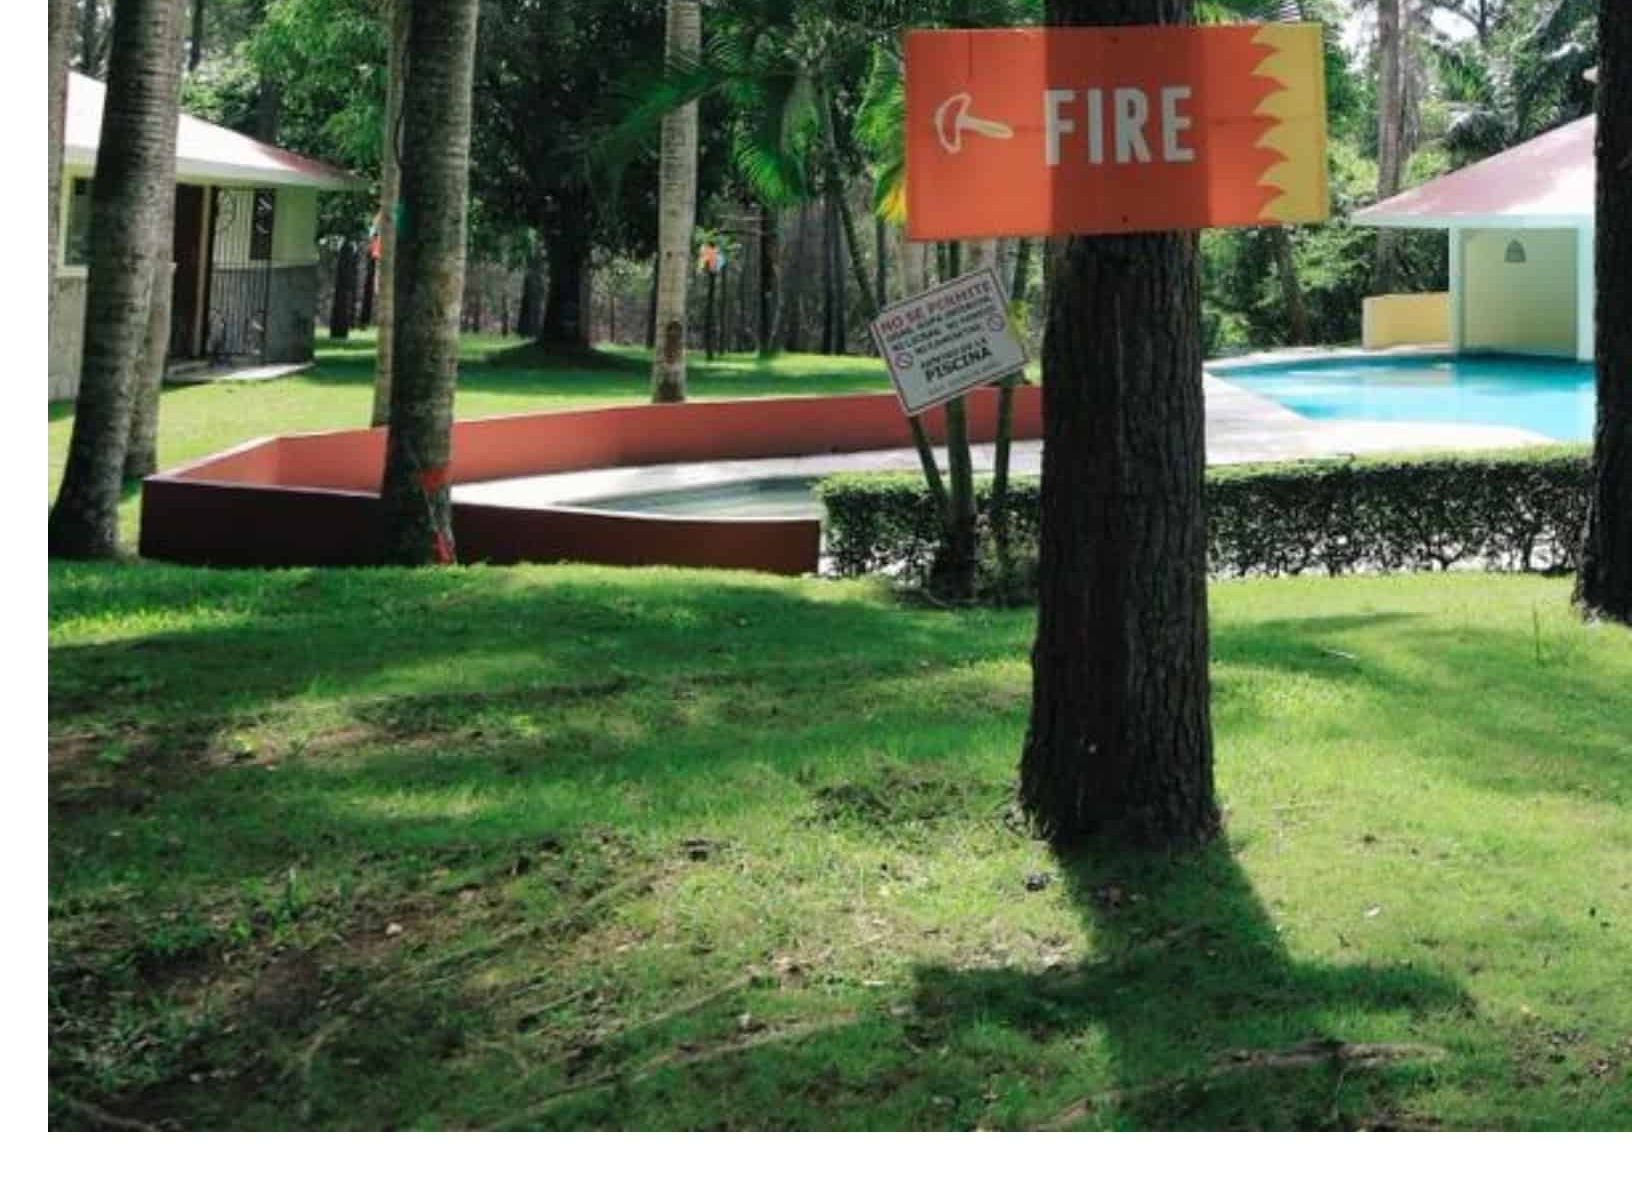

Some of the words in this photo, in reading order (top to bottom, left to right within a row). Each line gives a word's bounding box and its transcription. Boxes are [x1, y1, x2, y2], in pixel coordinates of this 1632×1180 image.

[1042, 85, 1195, 166] FIRE
[879, 314, 904, 333] NO
[905, 306, 923, 322] SE
[927, 280, 992, 314] PERMITE
[924, 345, 992, 382] PISCINA
